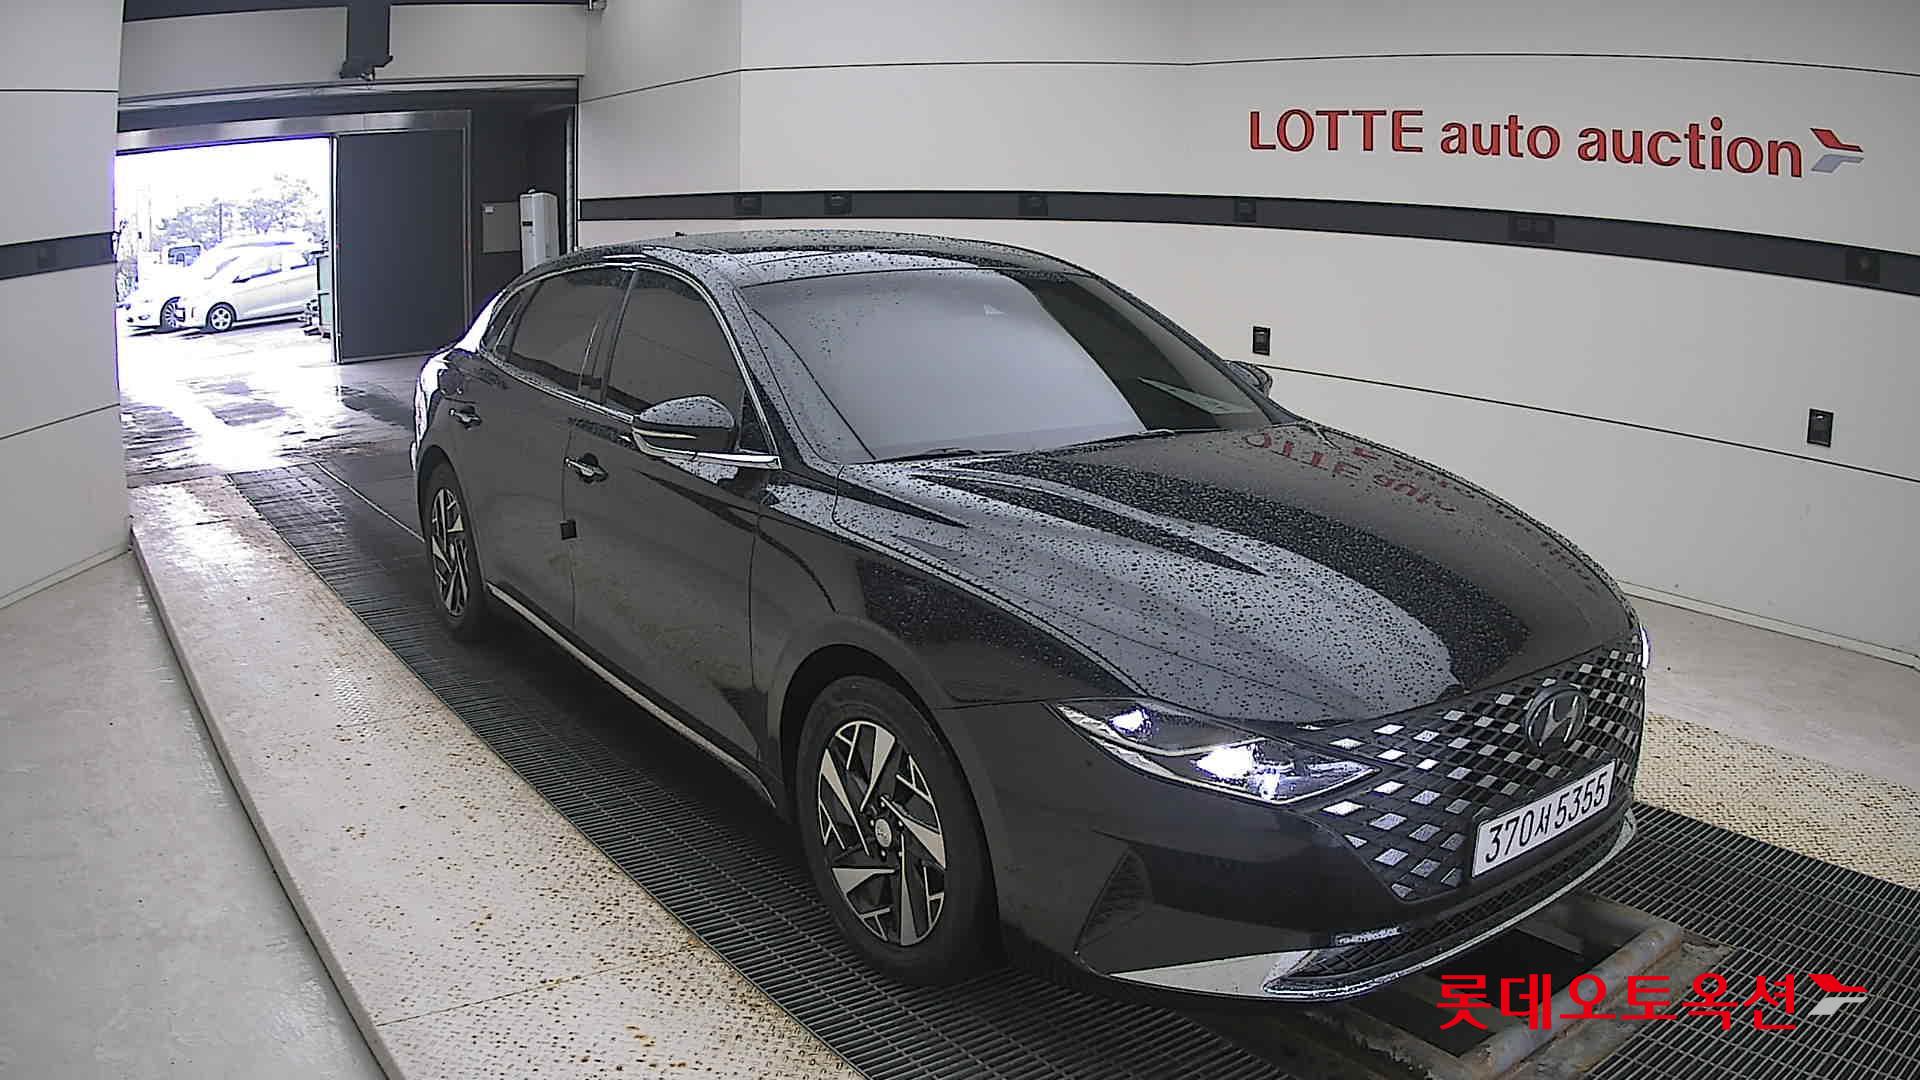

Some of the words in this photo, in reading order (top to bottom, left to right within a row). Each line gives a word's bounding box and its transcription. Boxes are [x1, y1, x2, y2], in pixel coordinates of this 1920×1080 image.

[1249, 109, 1424, 153] LOTTE
[1440, 114, 1562, 159] auto
[1576, 116, 1803, 178] auction
